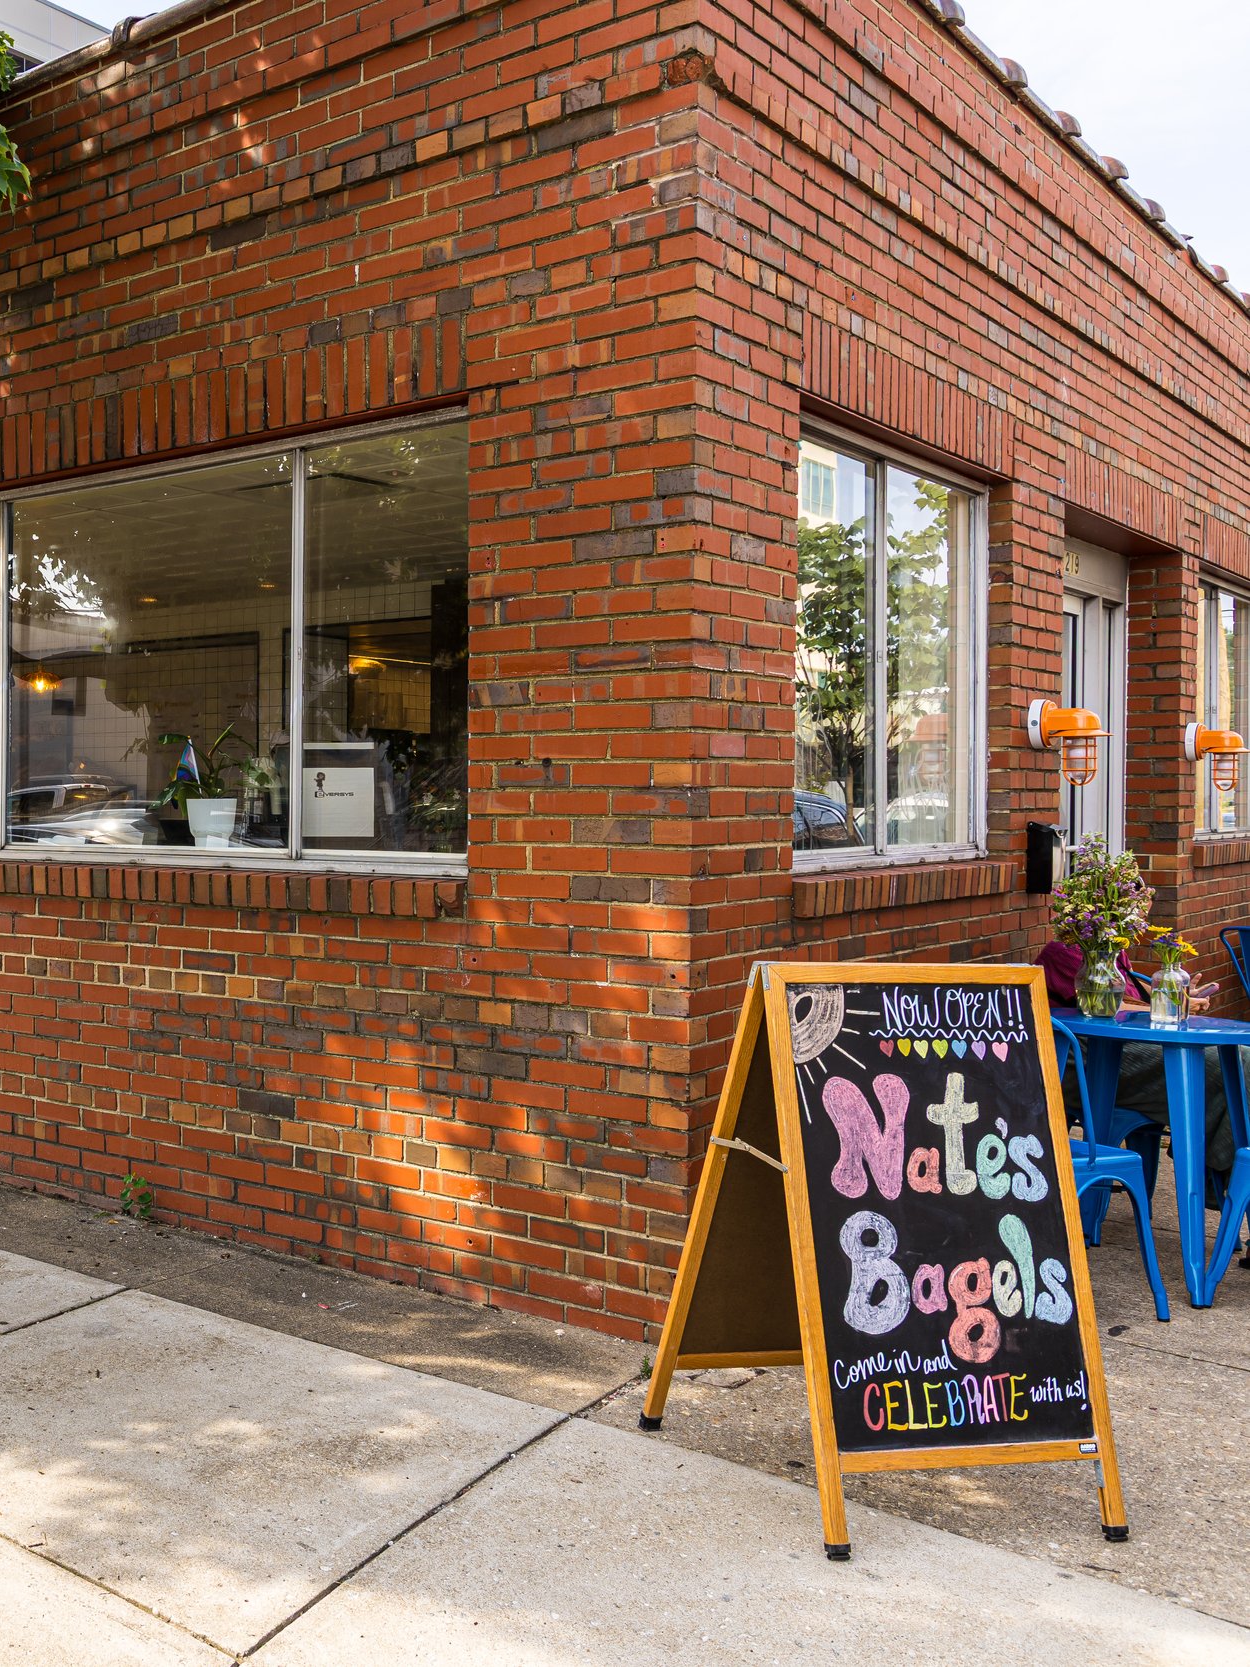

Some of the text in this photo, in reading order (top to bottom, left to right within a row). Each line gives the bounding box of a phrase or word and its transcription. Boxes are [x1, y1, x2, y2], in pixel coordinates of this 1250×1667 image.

[1065, 552, 1080, 575] 219
[882, 986, 1023, 1029] NOW OPEN!!
[821, 1071, 1048, 1203] Nate's
[838, 1210, 1073, 1364] Bagels
[833, 1339, 958, 1390] Come in and
[863, 1370, 1087, 1431] CELEBRATE with us!
